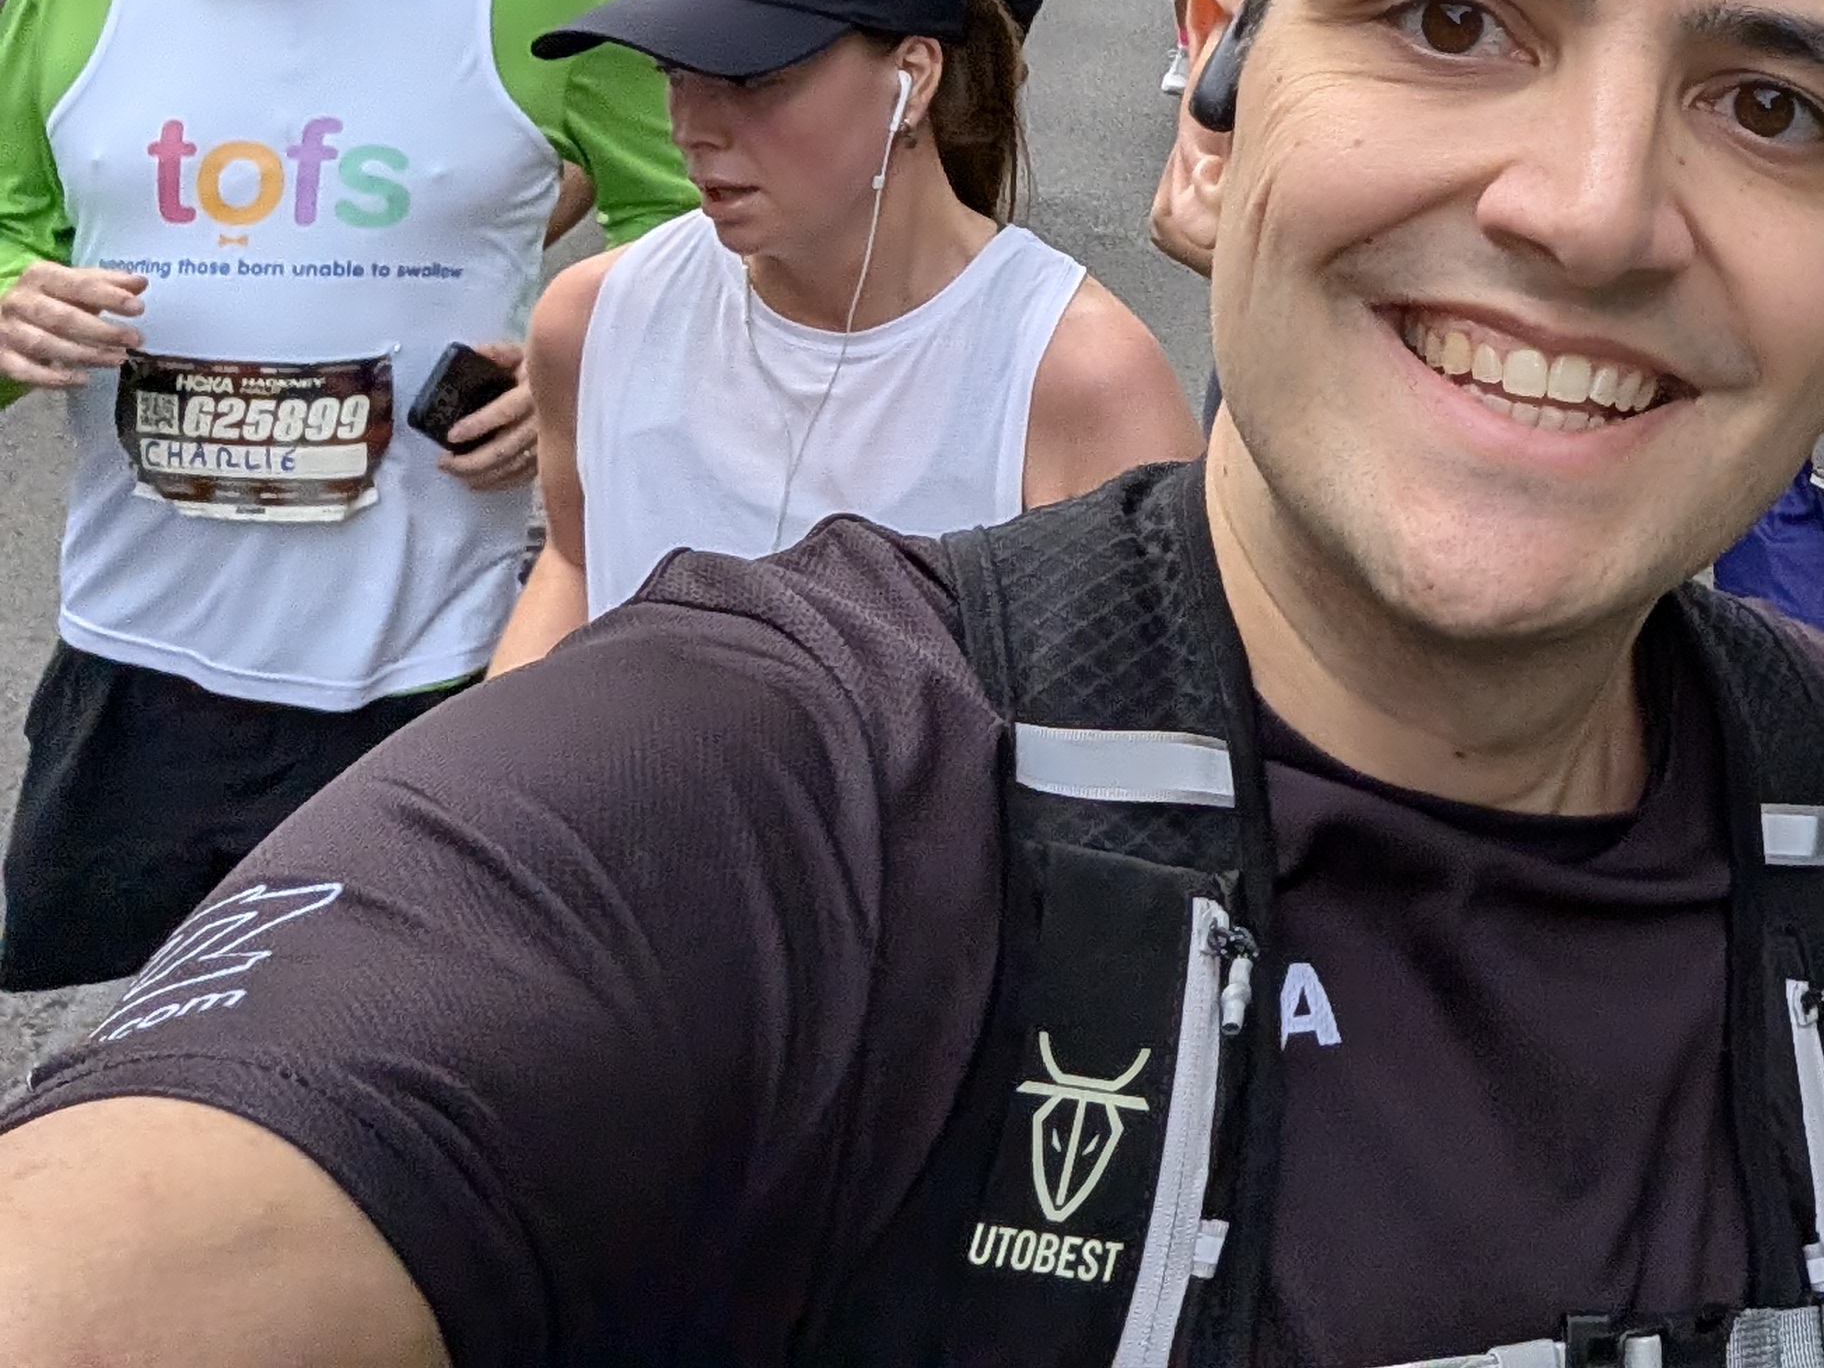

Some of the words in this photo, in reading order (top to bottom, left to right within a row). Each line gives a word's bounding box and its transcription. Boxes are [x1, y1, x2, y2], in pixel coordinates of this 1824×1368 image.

[148, 117, 411, 228] tofs
[178, 258, 231, 276] those
[237, 259, 285, 275] born
[292, 261, 364, 277] unable
[371, 262, 391, 277] to
[397, 262, 463, 279] swallow
[182, 395, 370, 442] G25899
[145, 440, 297, 472] CHARLIE
[967, 1222, 1125, 1283] UTOBEST
